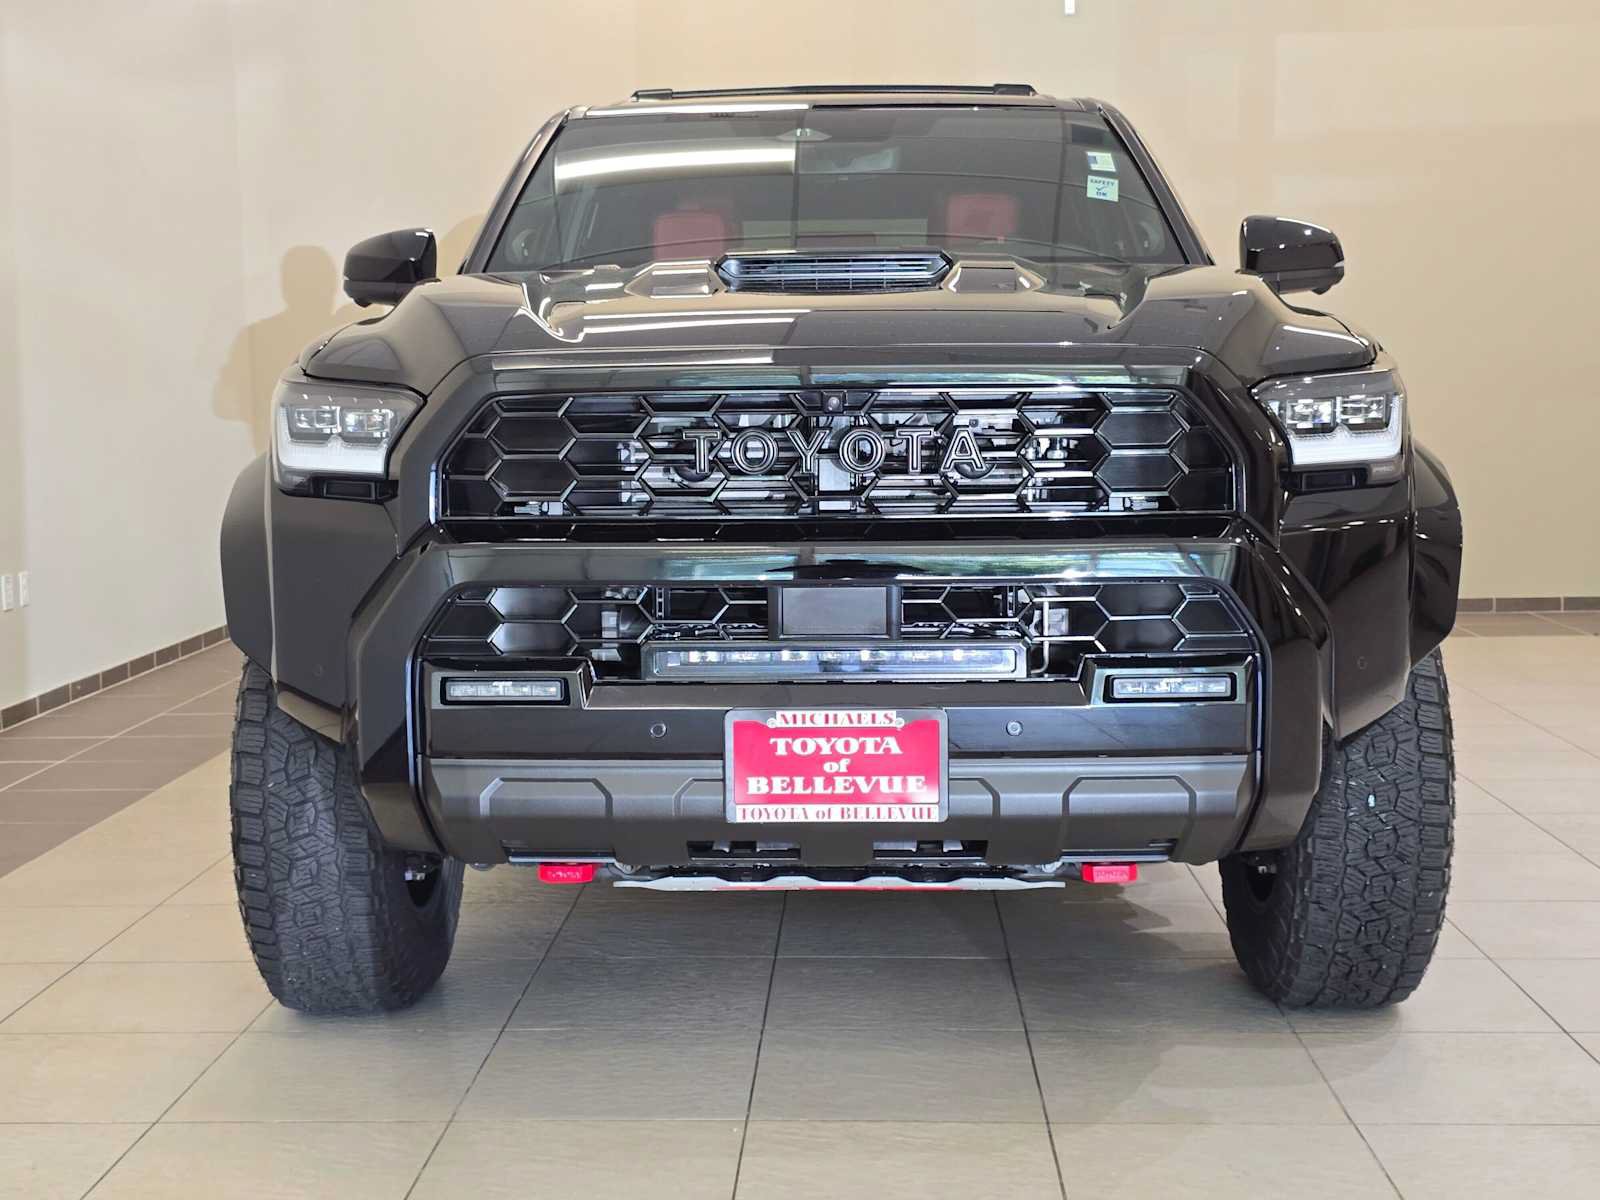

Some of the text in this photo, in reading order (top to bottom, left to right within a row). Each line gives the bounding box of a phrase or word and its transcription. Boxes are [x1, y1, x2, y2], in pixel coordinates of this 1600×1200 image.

[683, 428, 986, 474] TOYOTA
[780, 712, 894, 726] MICHAELS
[769, 736, 903, 755] TOYOTA
[823, 758, 850, 773] of
[746, 775, 927, 795] BELLEVUE
[740, 806, 936, 821] TOYOTA of BELLEVUE
